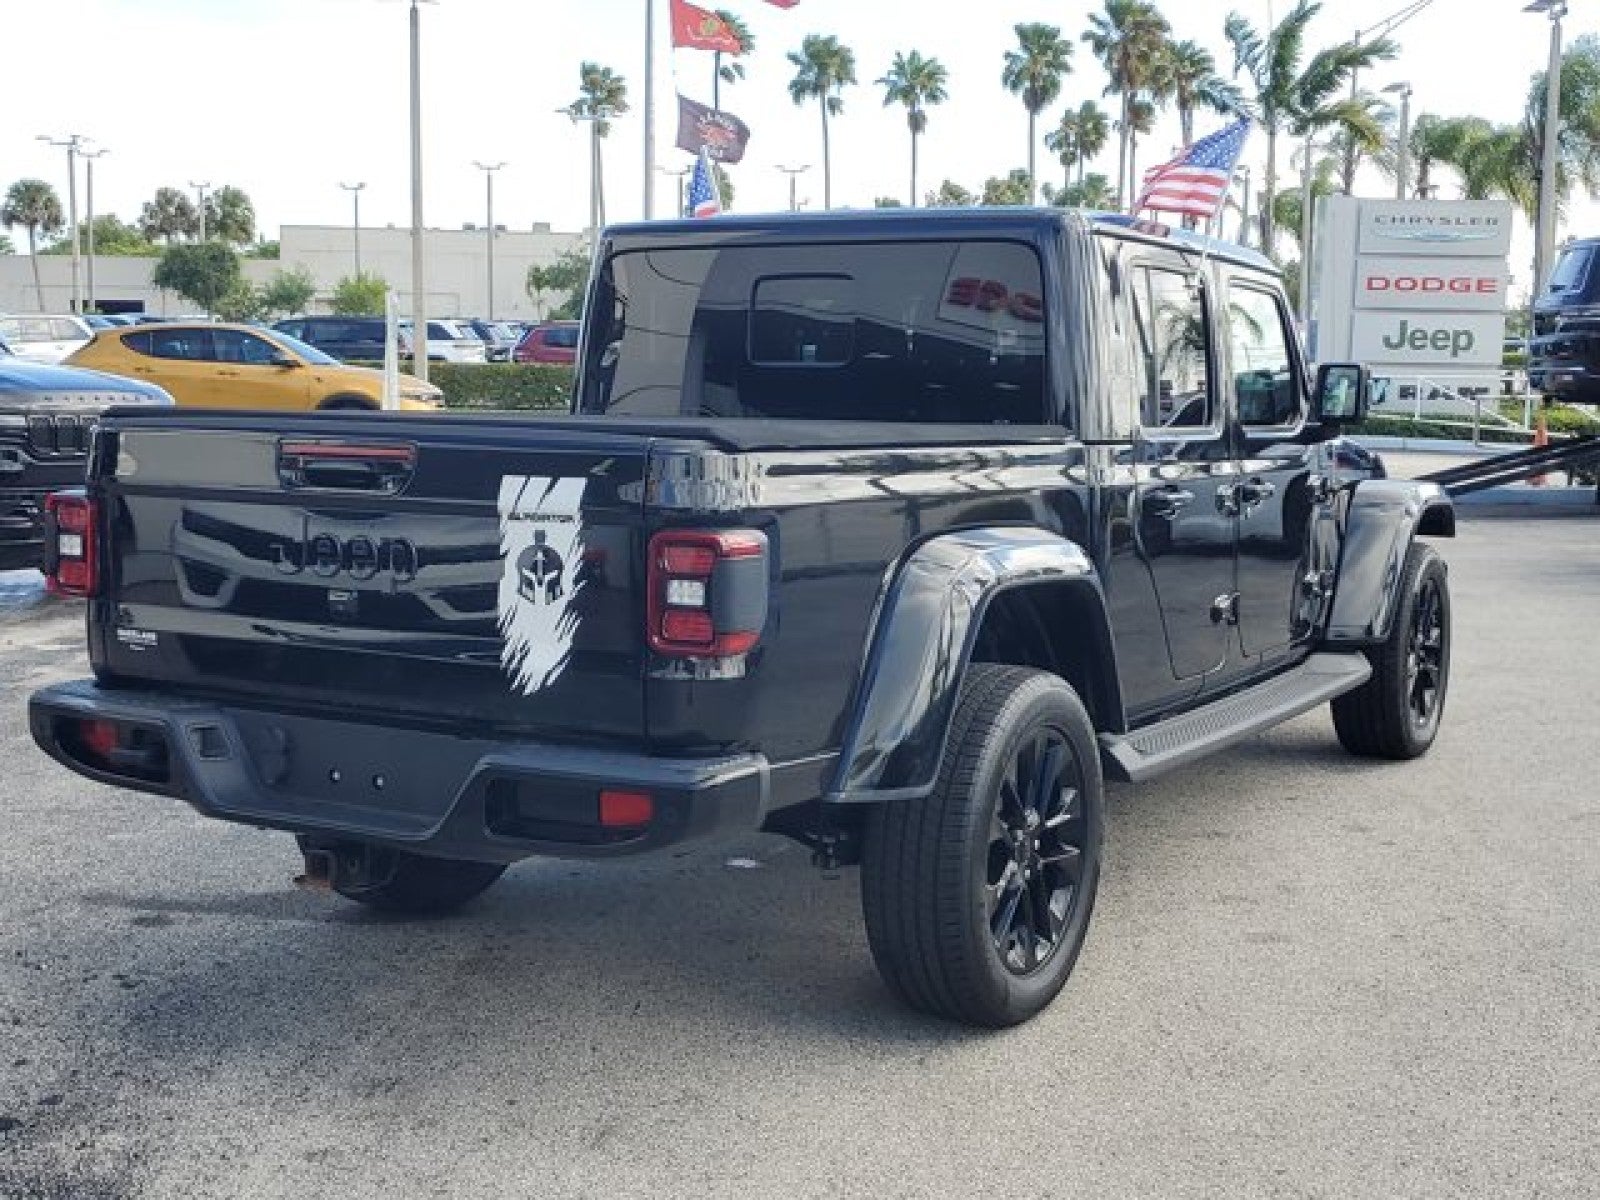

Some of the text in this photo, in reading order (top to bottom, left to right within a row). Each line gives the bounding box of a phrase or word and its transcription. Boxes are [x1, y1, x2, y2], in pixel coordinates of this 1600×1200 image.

[1374, 214, 1498, 226] CHRYSLER
[1366, 276, 1498, 293] DODGE
[1382, 319, 1475, 358] Jeep
[507, 512, 575, 523] GLADIATOR
[269, 513, 418, 596] Jeep
